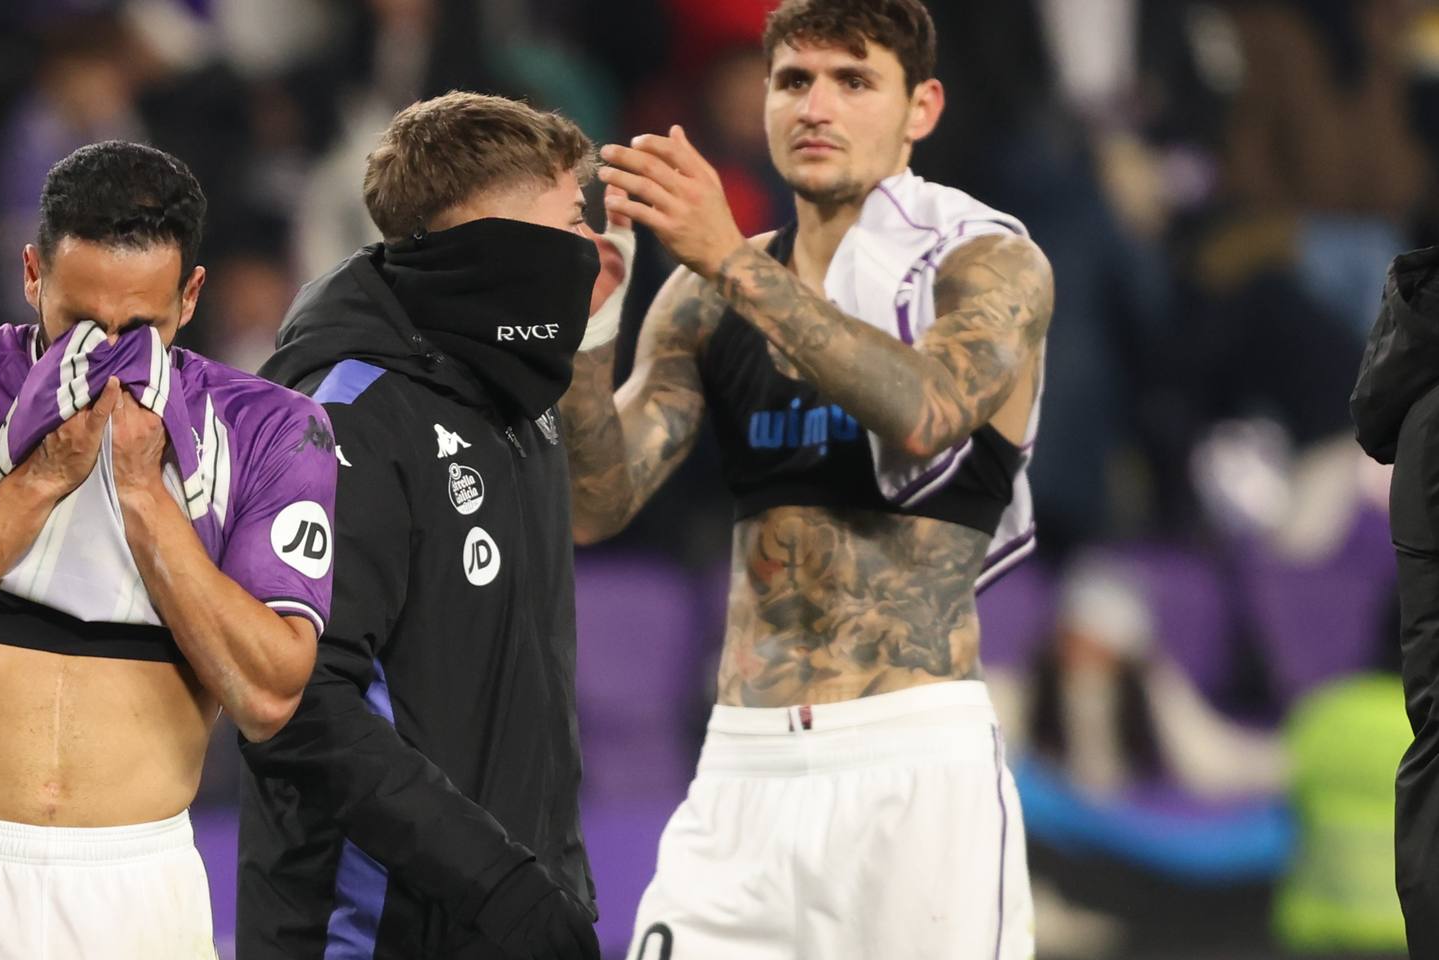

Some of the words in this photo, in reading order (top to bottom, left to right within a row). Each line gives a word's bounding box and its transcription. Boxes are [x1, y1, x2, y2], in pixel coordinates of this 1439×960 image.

[497, 324, 560, 341] RVCF
[282, 519, 328, 560] JD
[467, 539, 492, 575] JD
